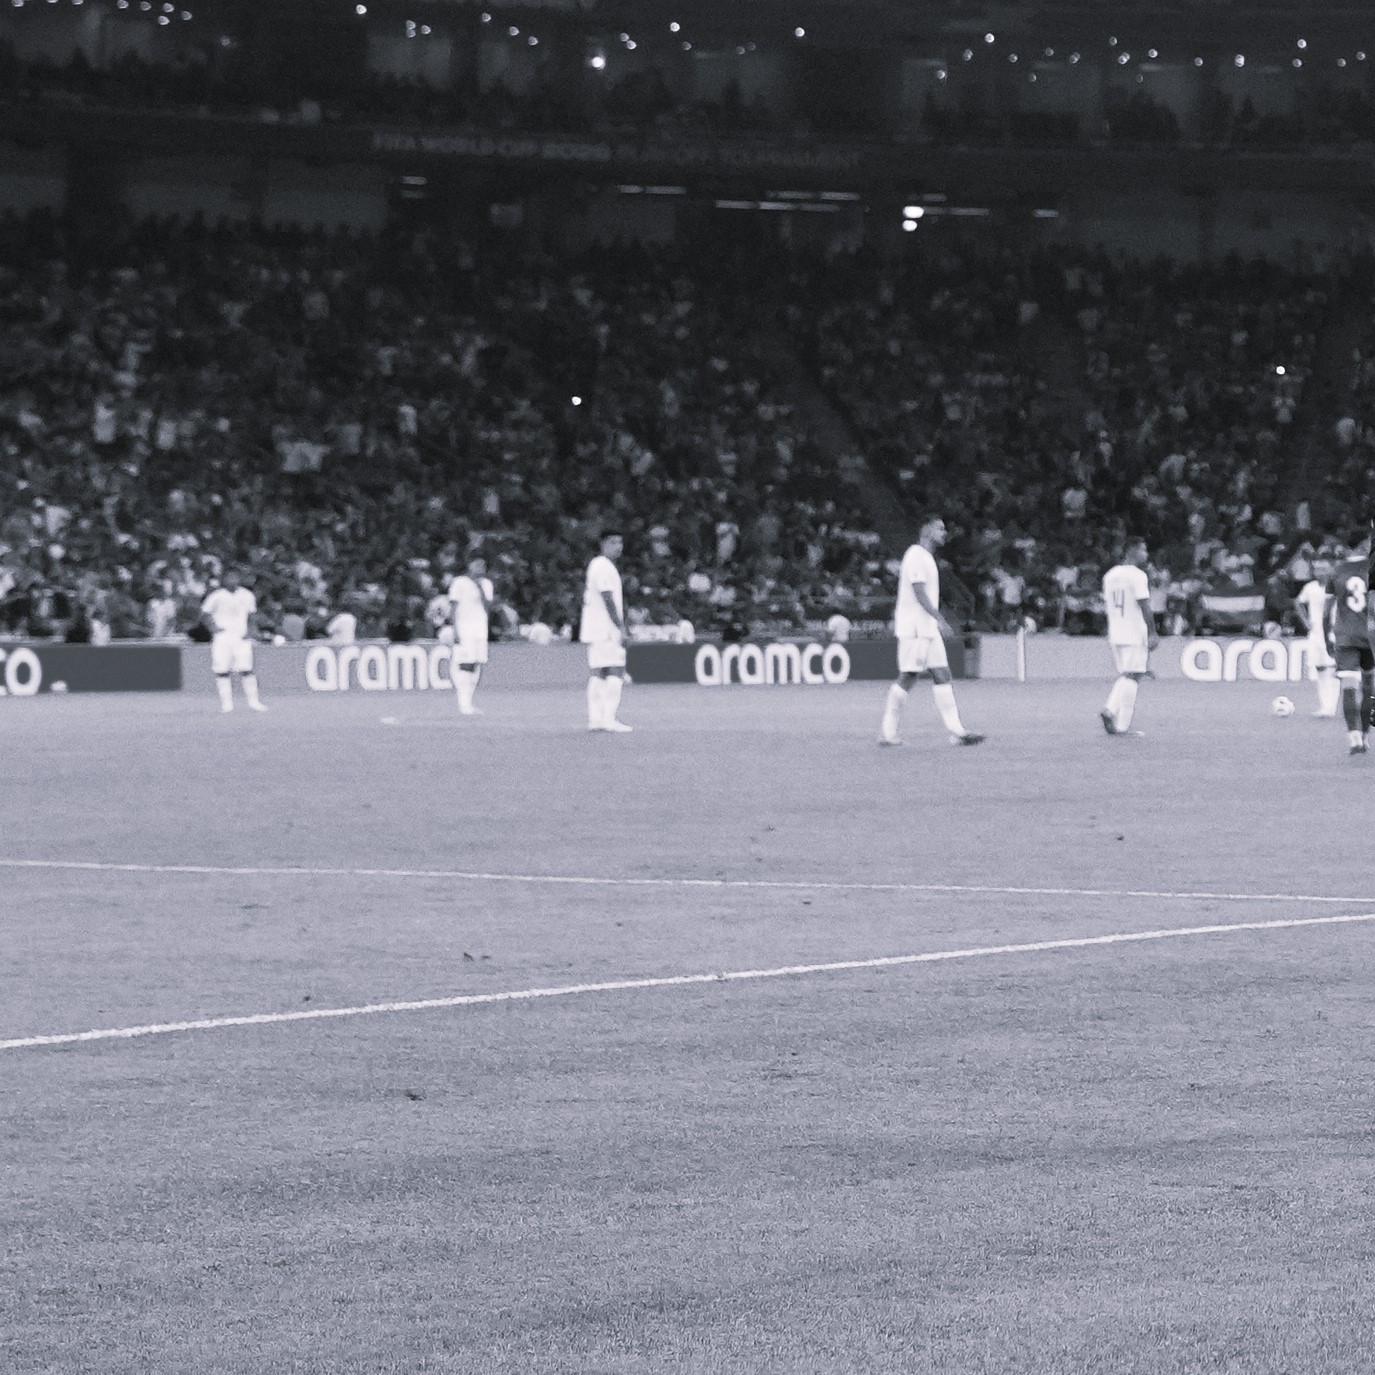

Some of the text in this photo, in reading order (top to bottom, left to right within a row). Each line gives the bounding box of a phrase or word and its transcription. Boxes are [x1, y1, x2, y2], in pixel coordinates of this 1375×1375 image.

[373, 133, 416, 151] FIFA
[421, 136, 496, 155] WORLD
[498, 140, 538, 158] CUP
[306, 645, 453, 691] aramc
[695, 643, 851, 686] aramco
